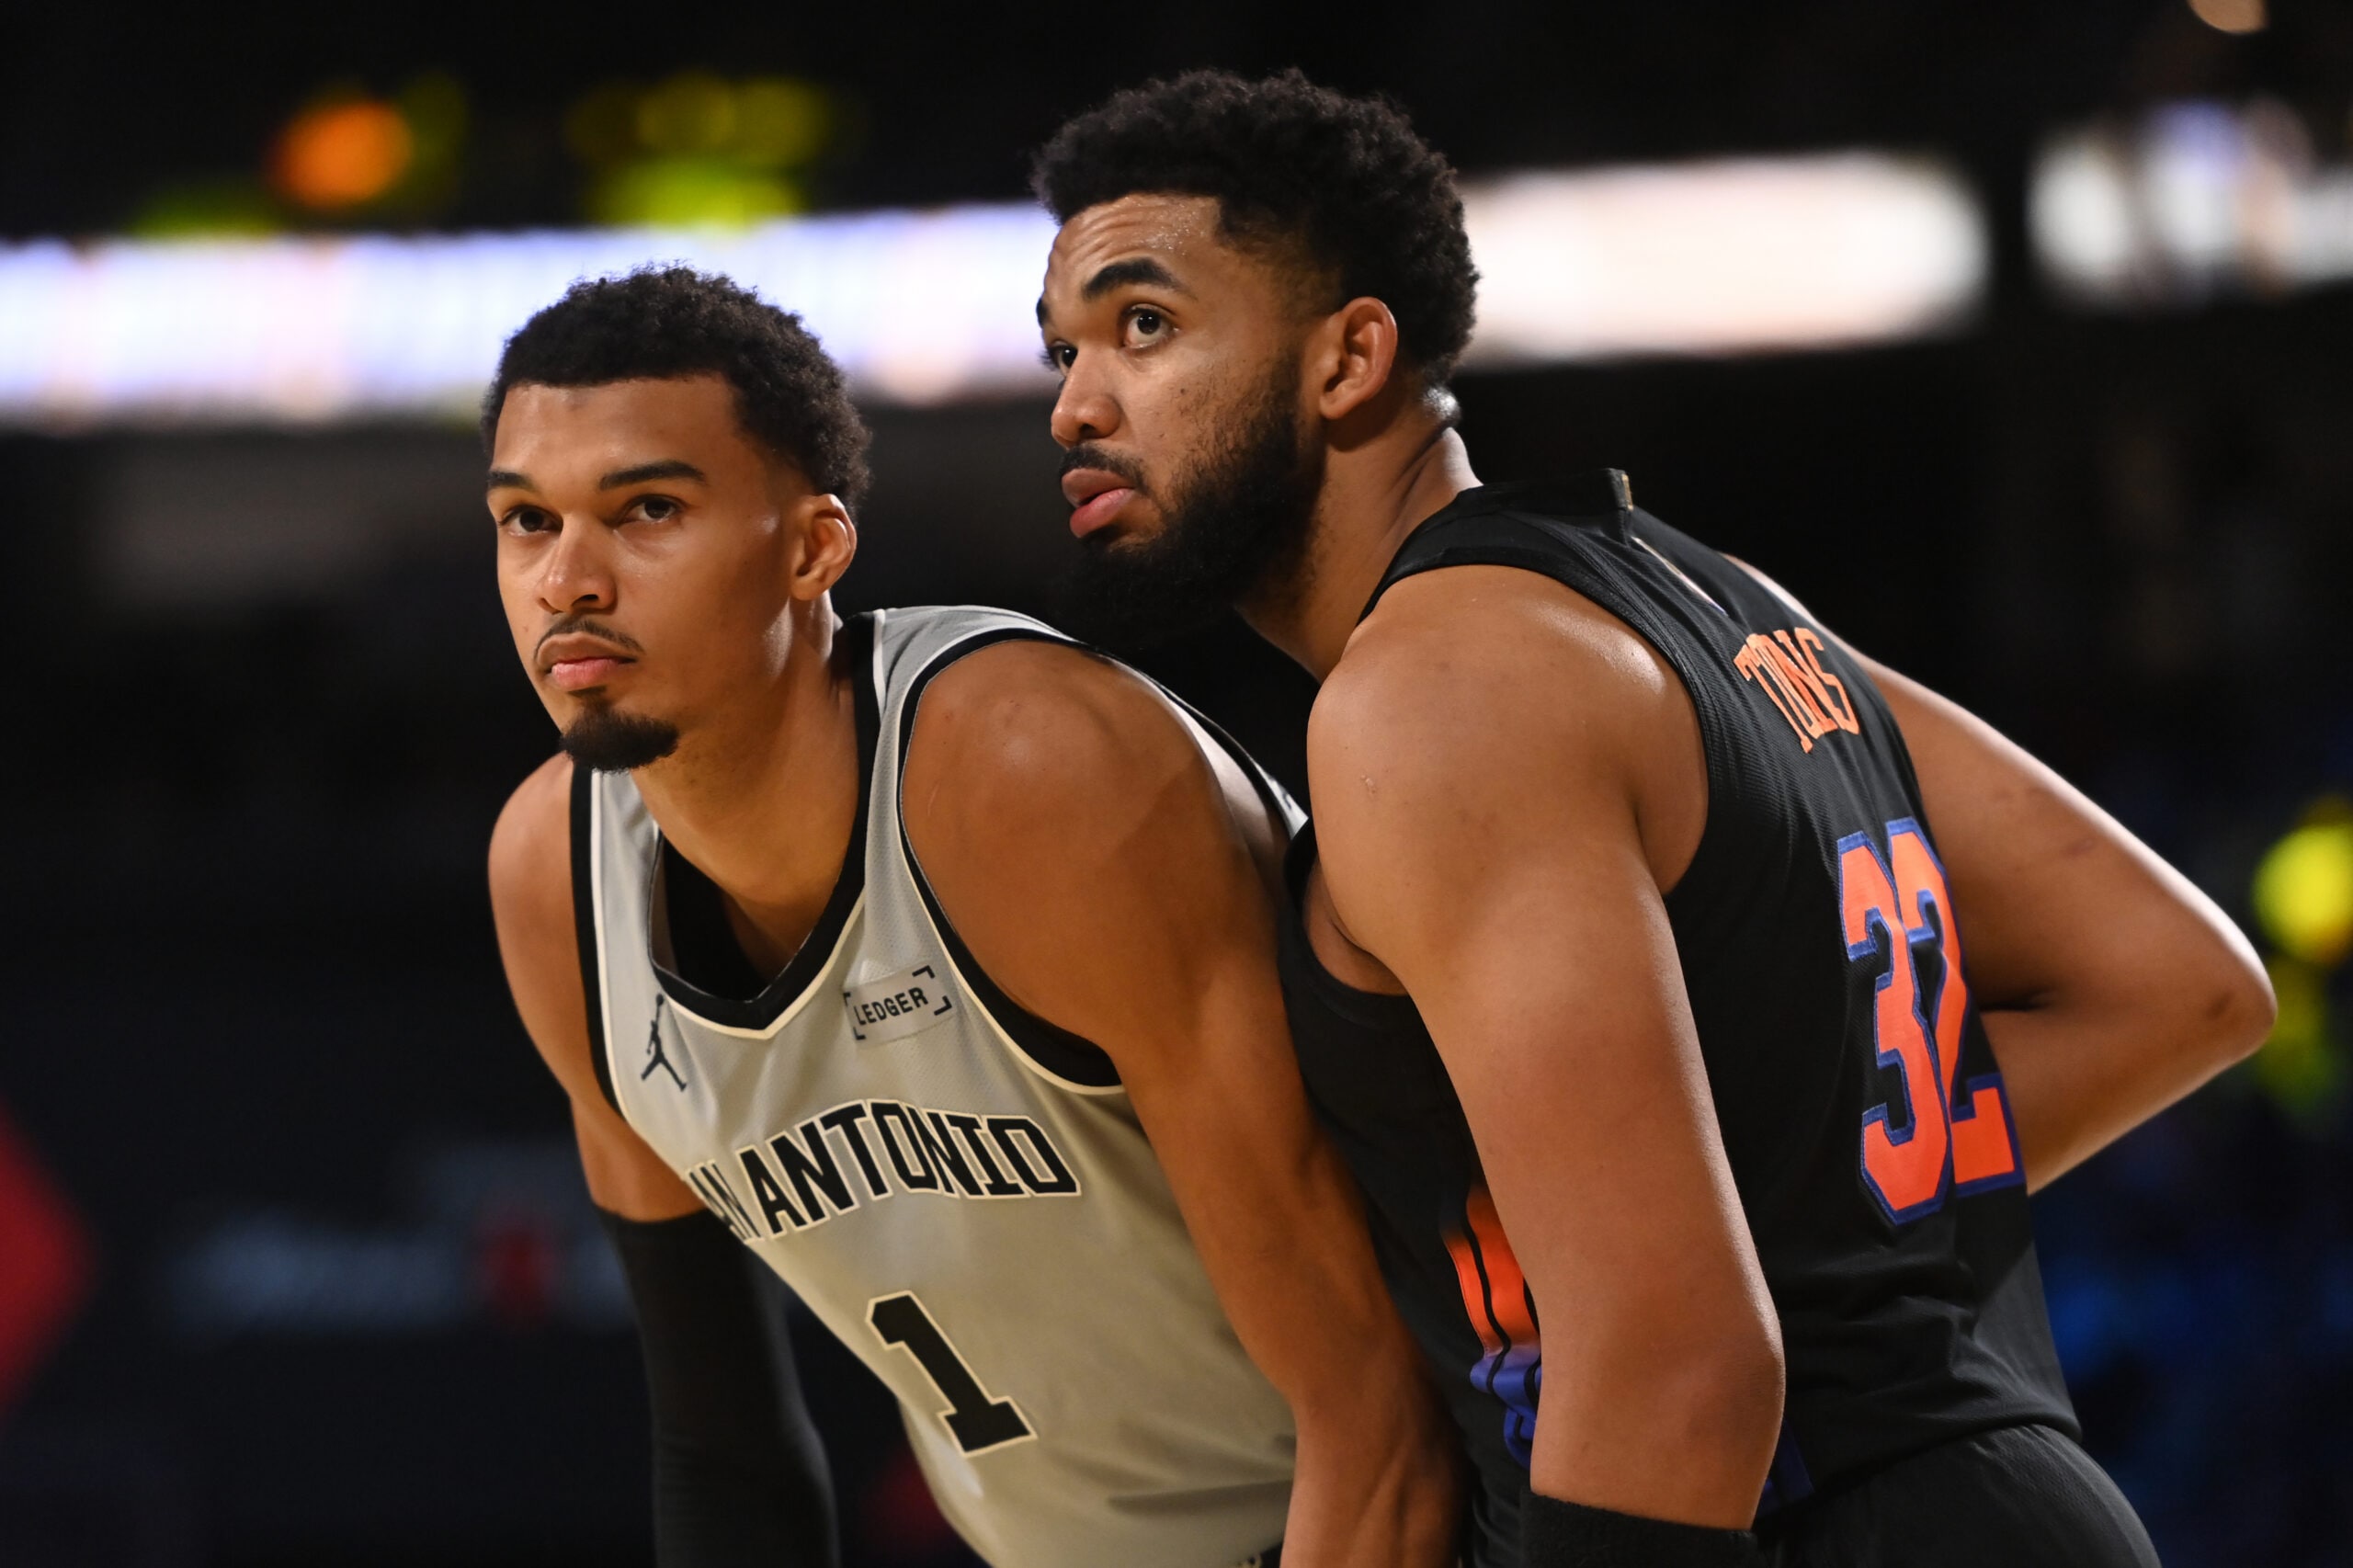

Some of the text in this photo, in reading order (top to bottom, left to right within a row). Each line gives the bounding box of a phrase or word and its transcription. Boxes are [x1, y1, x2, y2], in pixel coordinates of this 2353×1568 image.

[853, 986, 928, 1026] LEDGER
[1838, 817, 2022, 1225] 32
[736, 1098, 1081, 1238] ANTONIO
[865, 1290, 1038, 1458] 1
